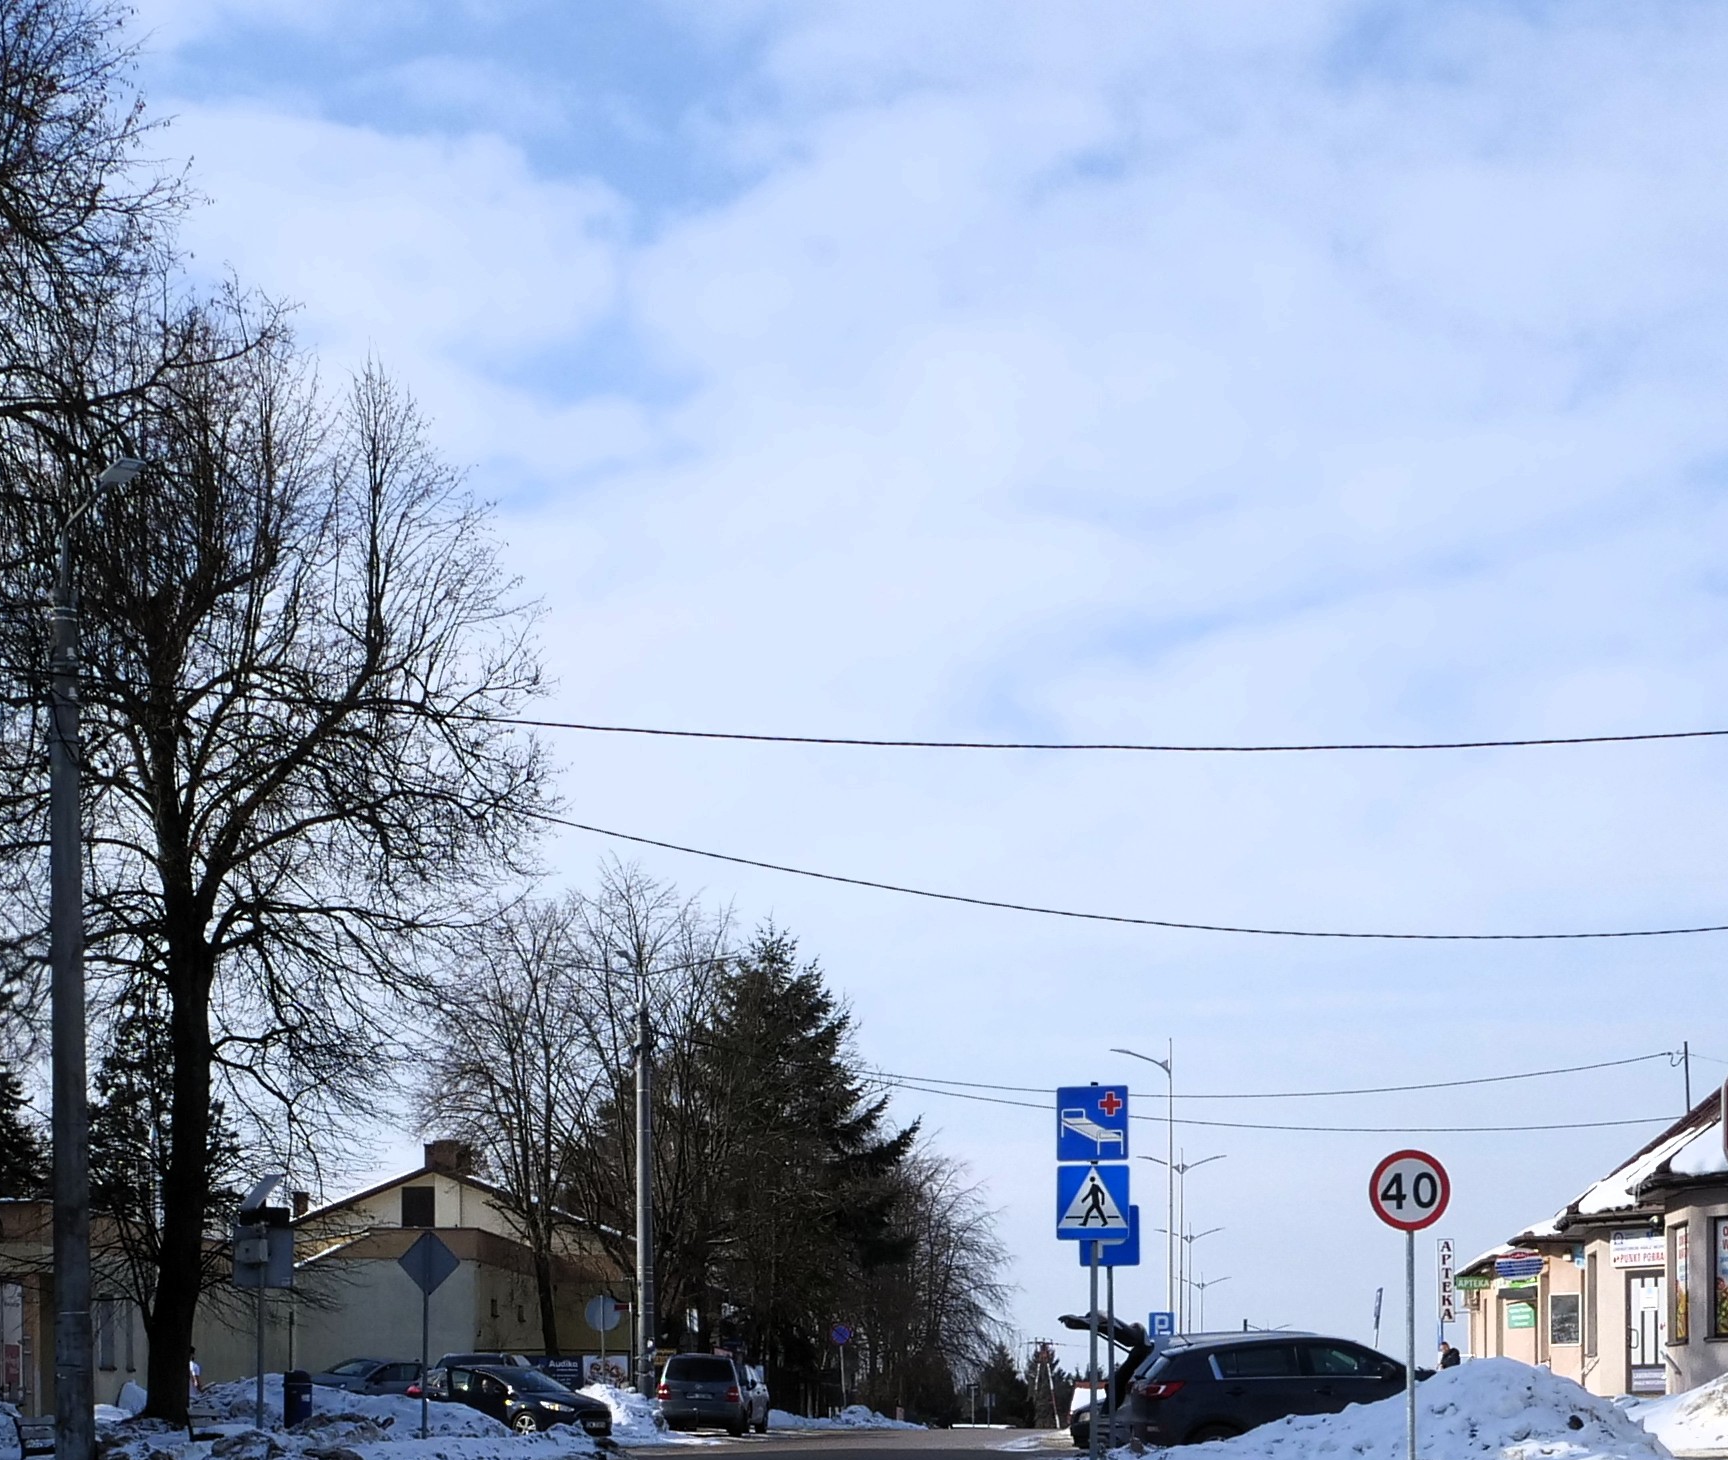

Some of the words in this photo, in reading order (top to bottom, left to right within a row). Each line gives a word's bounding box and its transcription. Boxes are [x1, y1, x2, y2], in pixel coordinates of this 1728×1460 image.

[1380, 1172, 1438, 1211] 40
[1440, 1241, 1453, 1320] APTEKA
[1458, 1280, 1490, 1288] APTEKA
